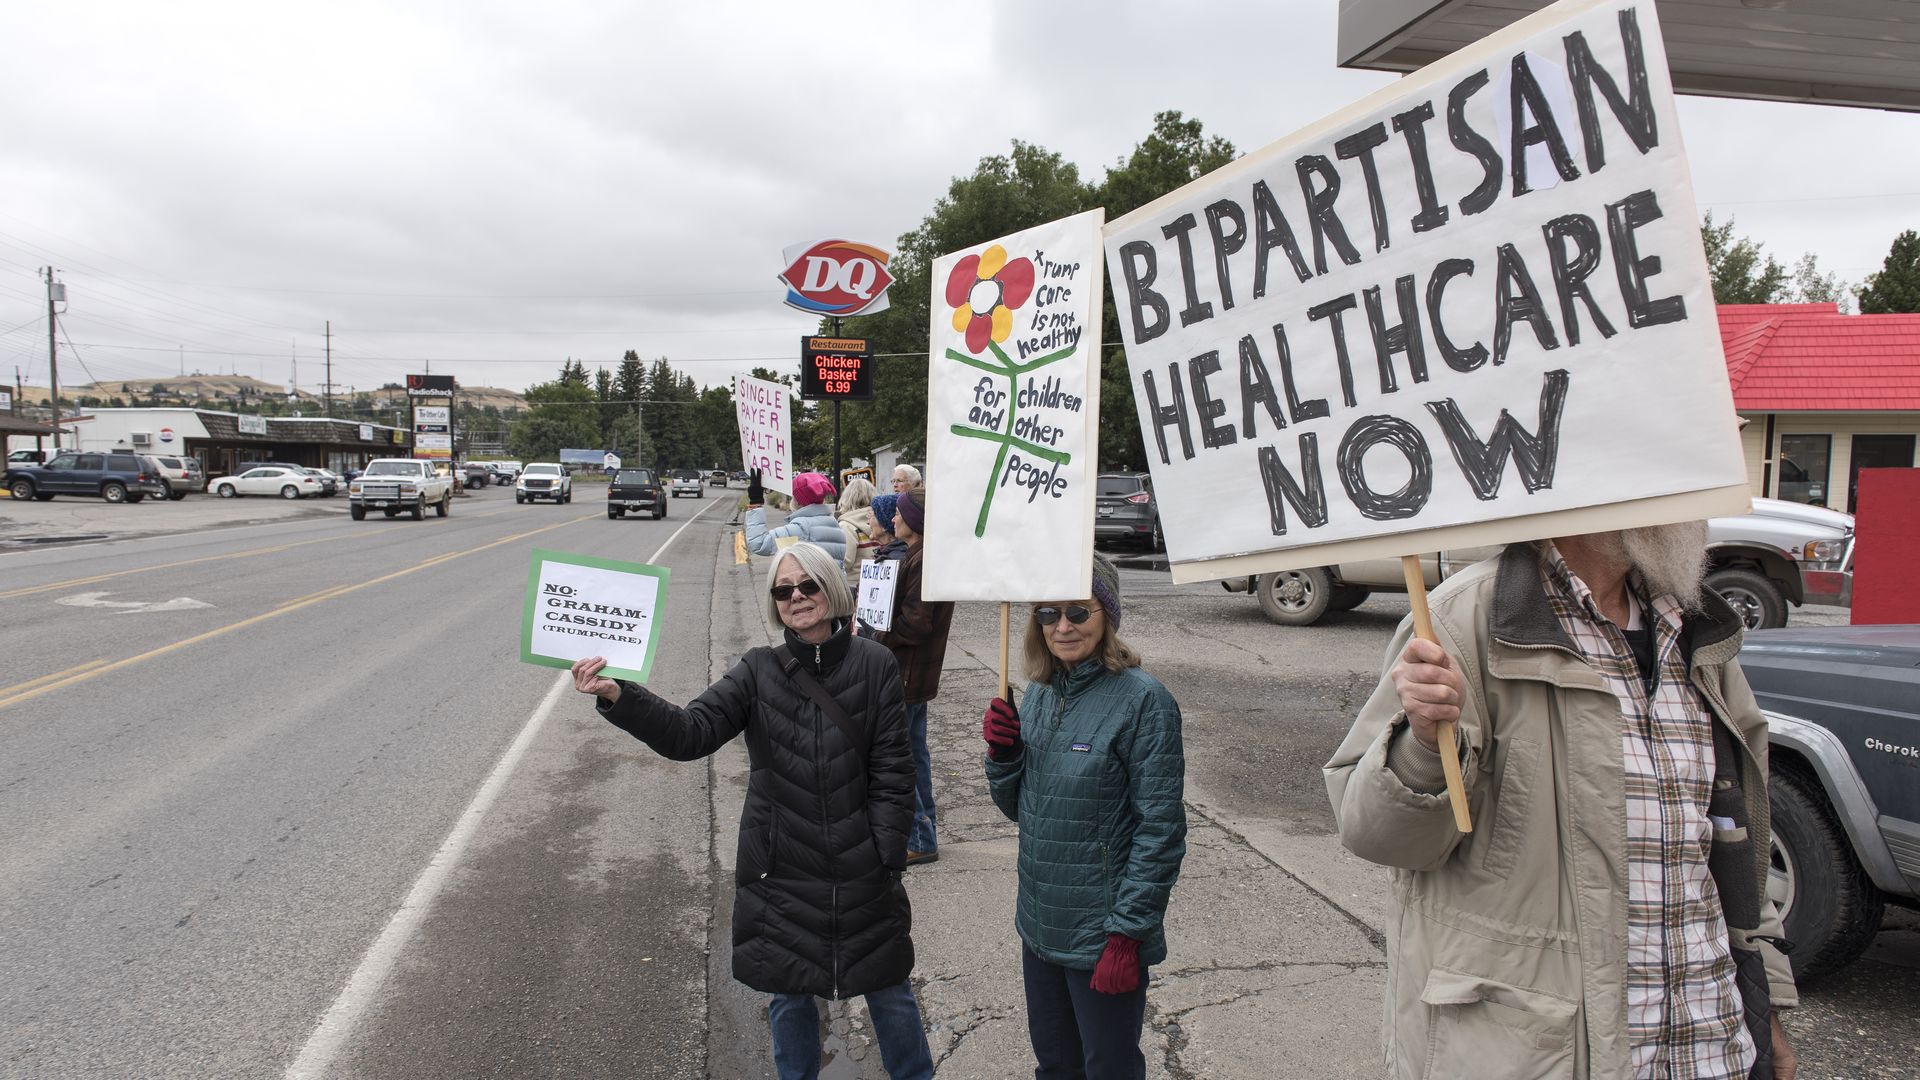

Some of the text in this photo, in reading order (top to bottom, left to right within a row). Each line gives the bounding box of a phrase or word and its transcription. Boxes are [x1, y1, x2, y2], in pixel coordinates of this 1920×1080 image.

[1119, 6, 1659, 346] BIPARTISAN
[801, 256, 876, 300] DQ
[1031, 310, 1075, 332] is not
[1142, 189, 1688, 465] HEALTHCARE
[811, 340, 864, 350] Restaurant
[1017, 325, 1081, 359] healthy
[815, 355, 861, 368] Chicken
[819, 368, 857, 381] Basket
[408, 388, 453, 396] RadioShack
[740, 380, 782, 409] SINGLE
[825, 381, 851, 393] 6.99
[974, 375, 1082, 412] for children
[741, 402, 779, 431] PAYER
[968, 406, 1063, 446] and other
[742, 424, 785, 456] HEALTH
[1258, 369, 1571, 537] NOW
[747, 449, 784, 480] CARE
[847, 472, 868, 481] Drive
[1001, 454, 1067, 504] people
[862, 564, 891, 580] HEALTH CARE
[543, 583, 577, 597] NO:
[547, 598, 647, 619] GRAHAM-
[873, 610, 885, 624] CARE
[545, 611, 638, 632] CASSIDY
[542, 624, 642, 645] (TRUMPCARE)
[1864, 737, 1920, 758] Cherok
